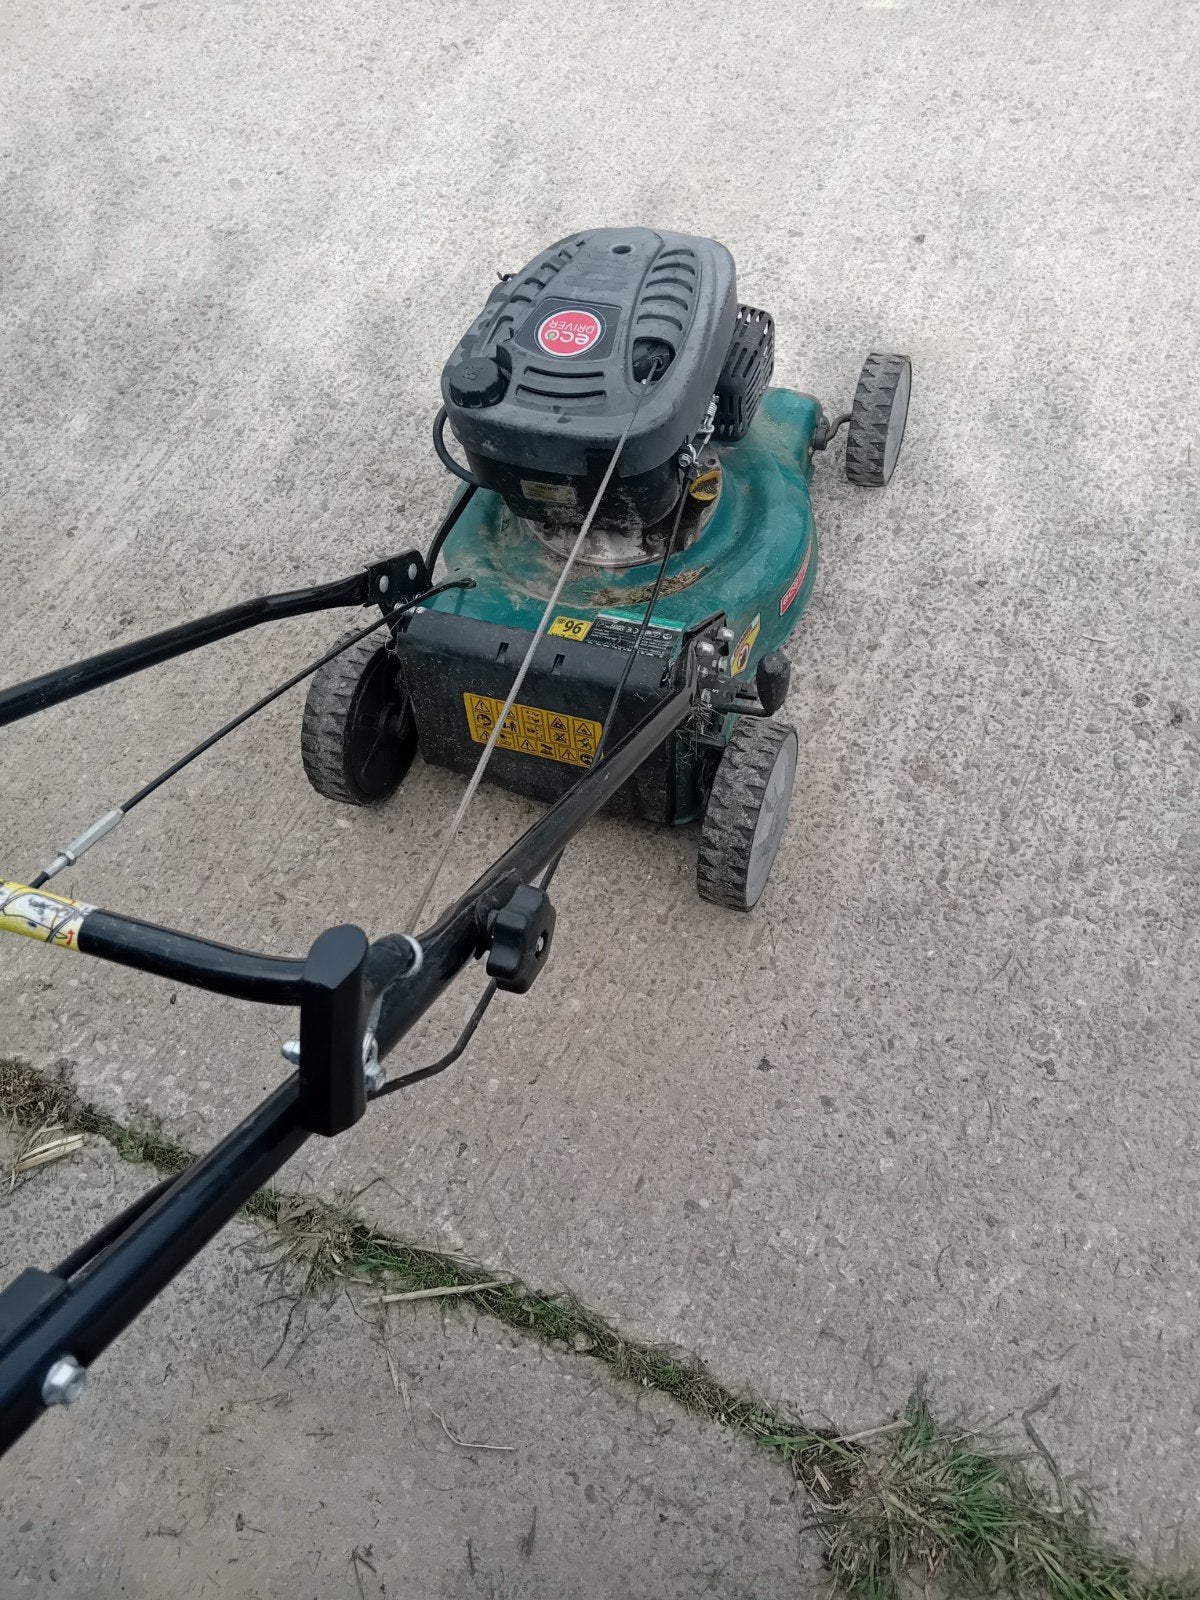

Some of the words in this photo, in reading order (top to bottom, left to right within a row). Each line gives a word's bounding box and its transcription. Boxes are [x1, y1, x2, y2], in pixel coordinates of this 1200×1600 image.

[549, 320, 595, 334] DRIVER
[544, 329, 590, 345] eco
[563, 620, 584, 634] 96
